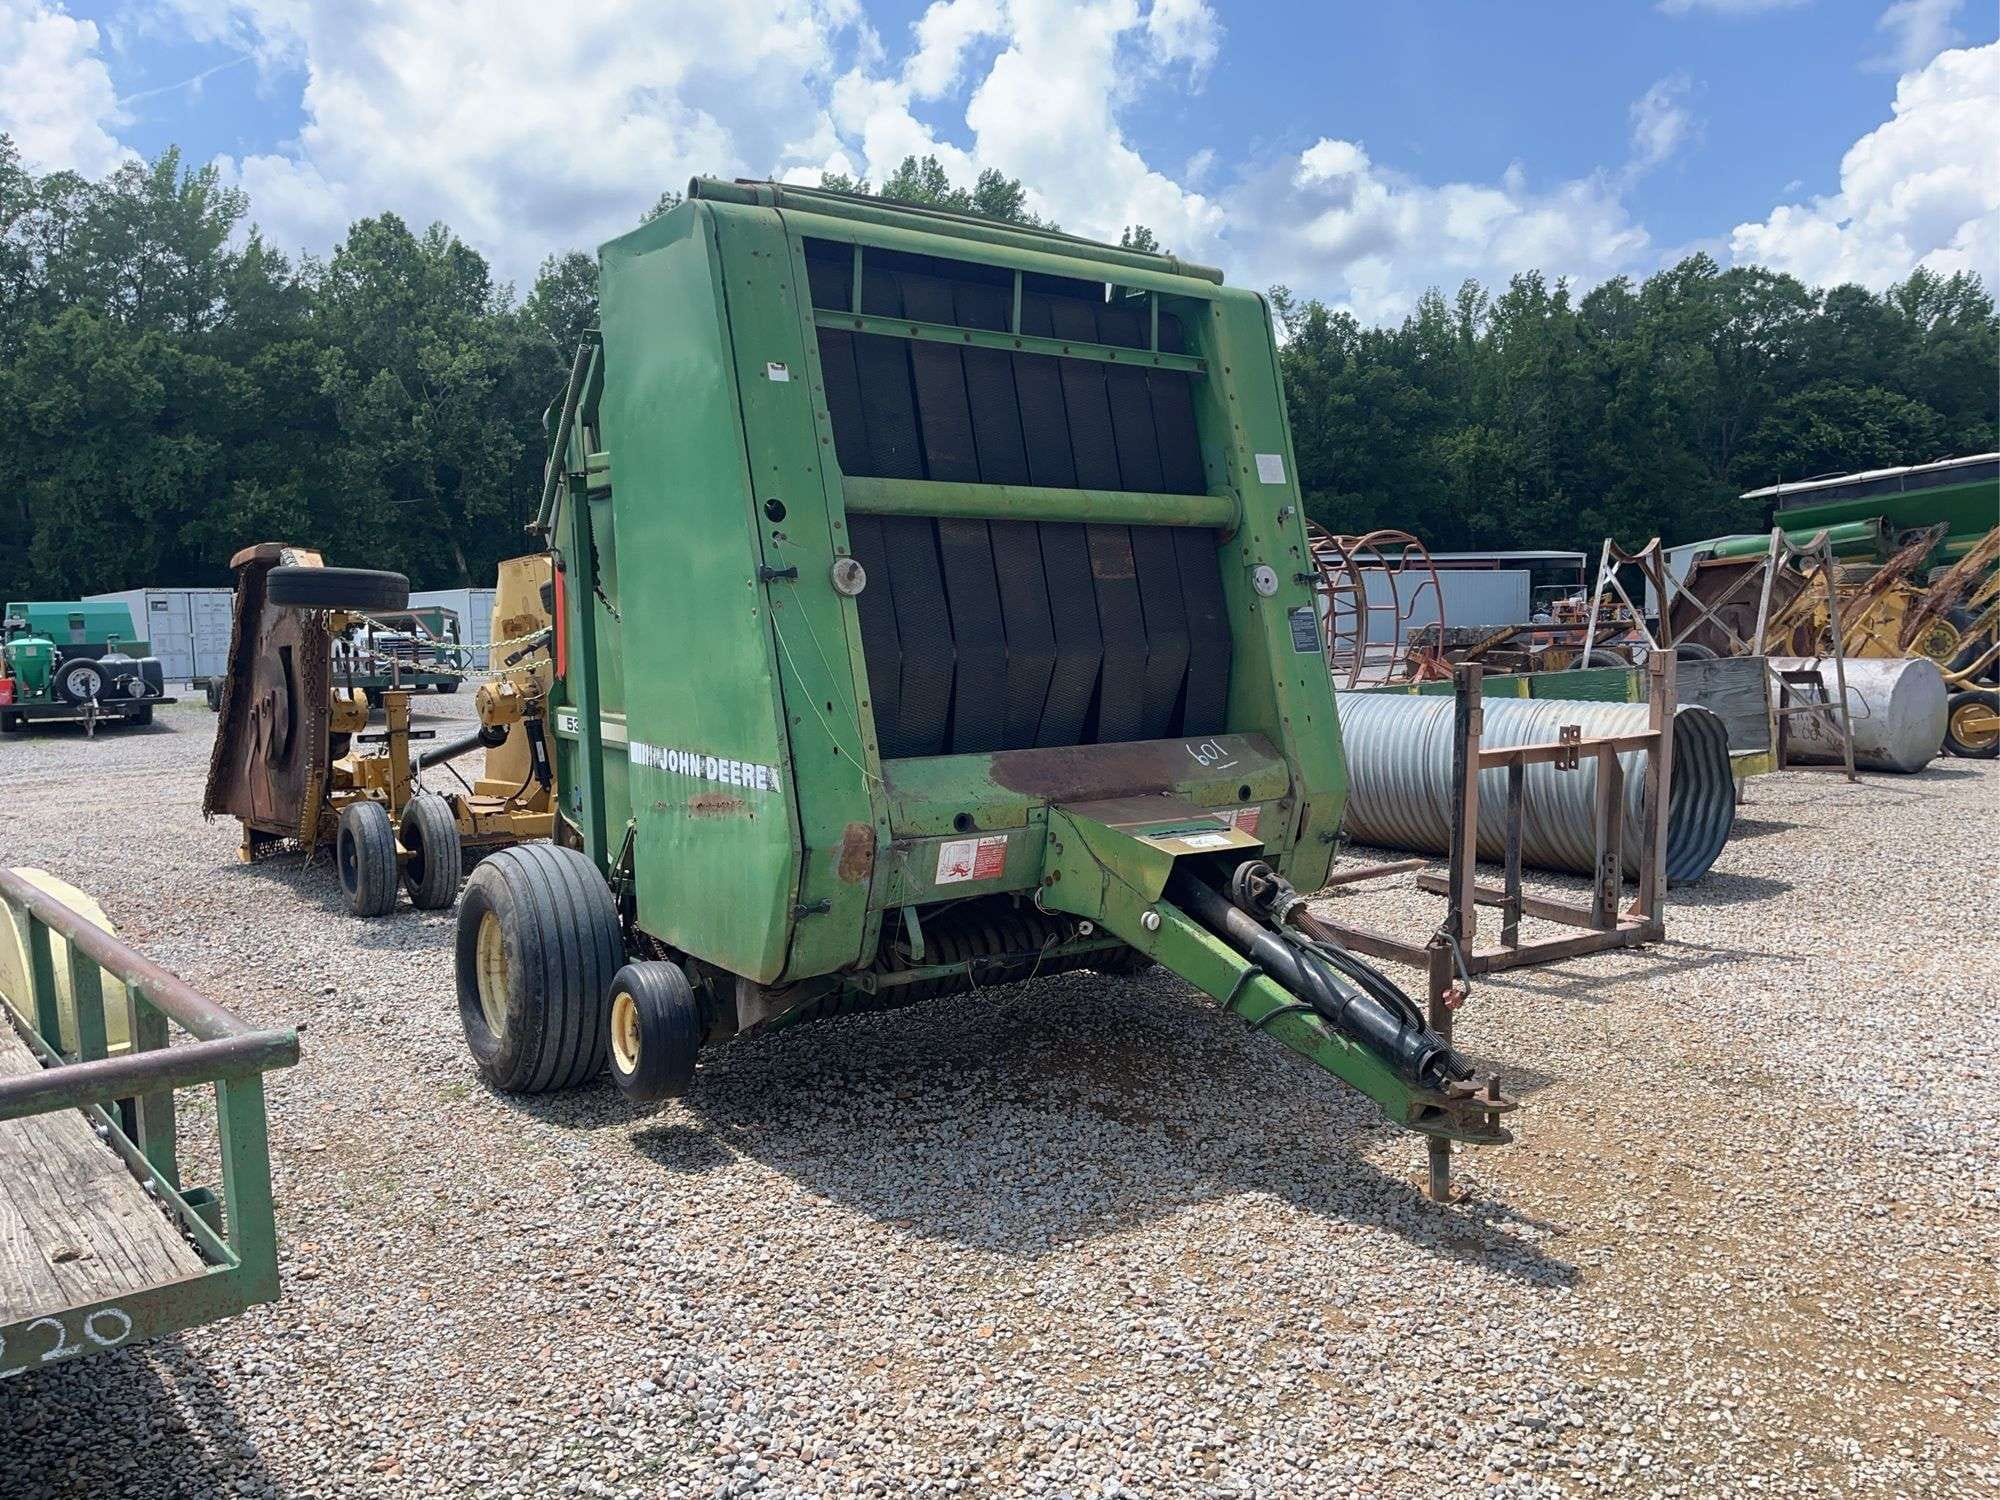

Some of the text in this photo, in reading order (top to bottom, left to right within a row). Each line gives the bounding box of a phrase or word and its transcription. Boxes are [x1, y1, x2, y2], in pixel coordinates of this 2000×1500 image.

[660, 747, 769, 791] JOHN DEERE
[1186, 738, 1229, 767] 601
[0, 1308, 133, 1379] 20
